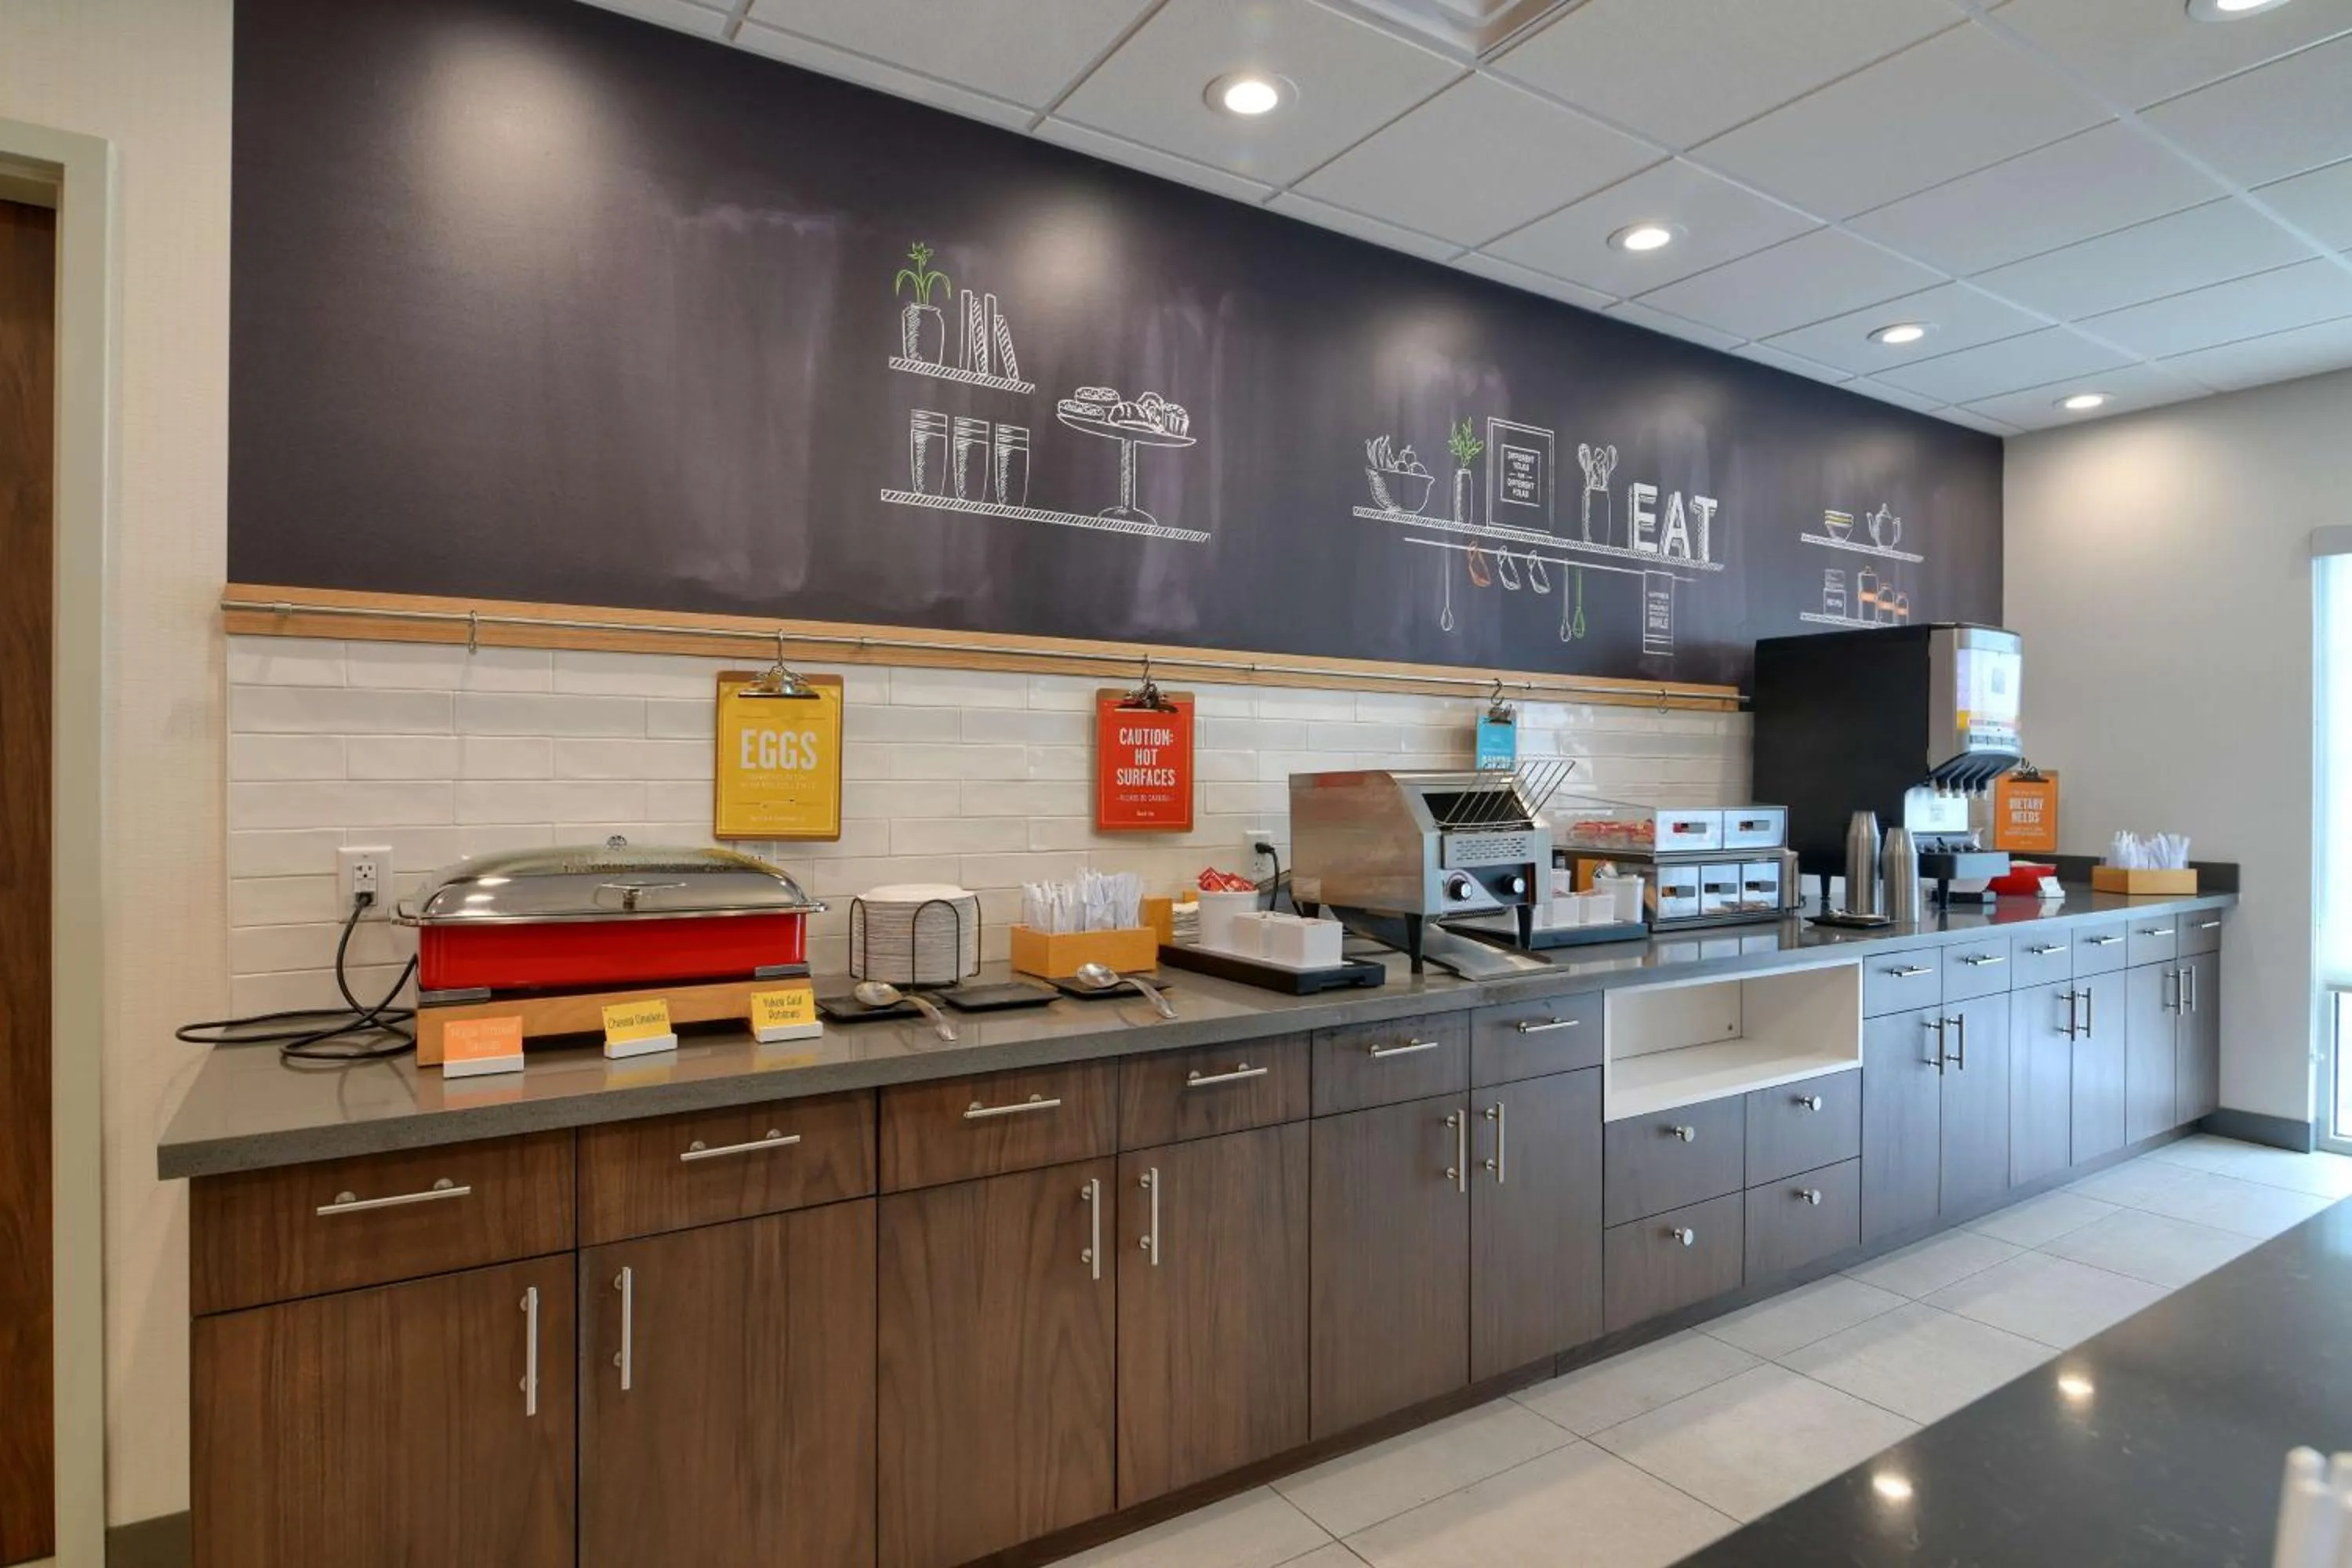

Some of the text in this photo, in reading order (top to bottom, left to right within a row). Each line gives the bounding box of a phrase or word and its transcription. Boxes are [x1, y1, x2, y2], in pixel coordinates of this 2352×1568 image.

[1628, 482, 1718, 563] EAT
[1119, 728, 1174, 746] CAUTION:
[740, 728, 818, 770] EGGS
[1134, 748, 1158, 766] HOT
[1116, 768, 1175, 786] SURFACES
[2009, 797, 2045, 810] DIETARY
[2011, 810, 2041, 823] NEEDS
